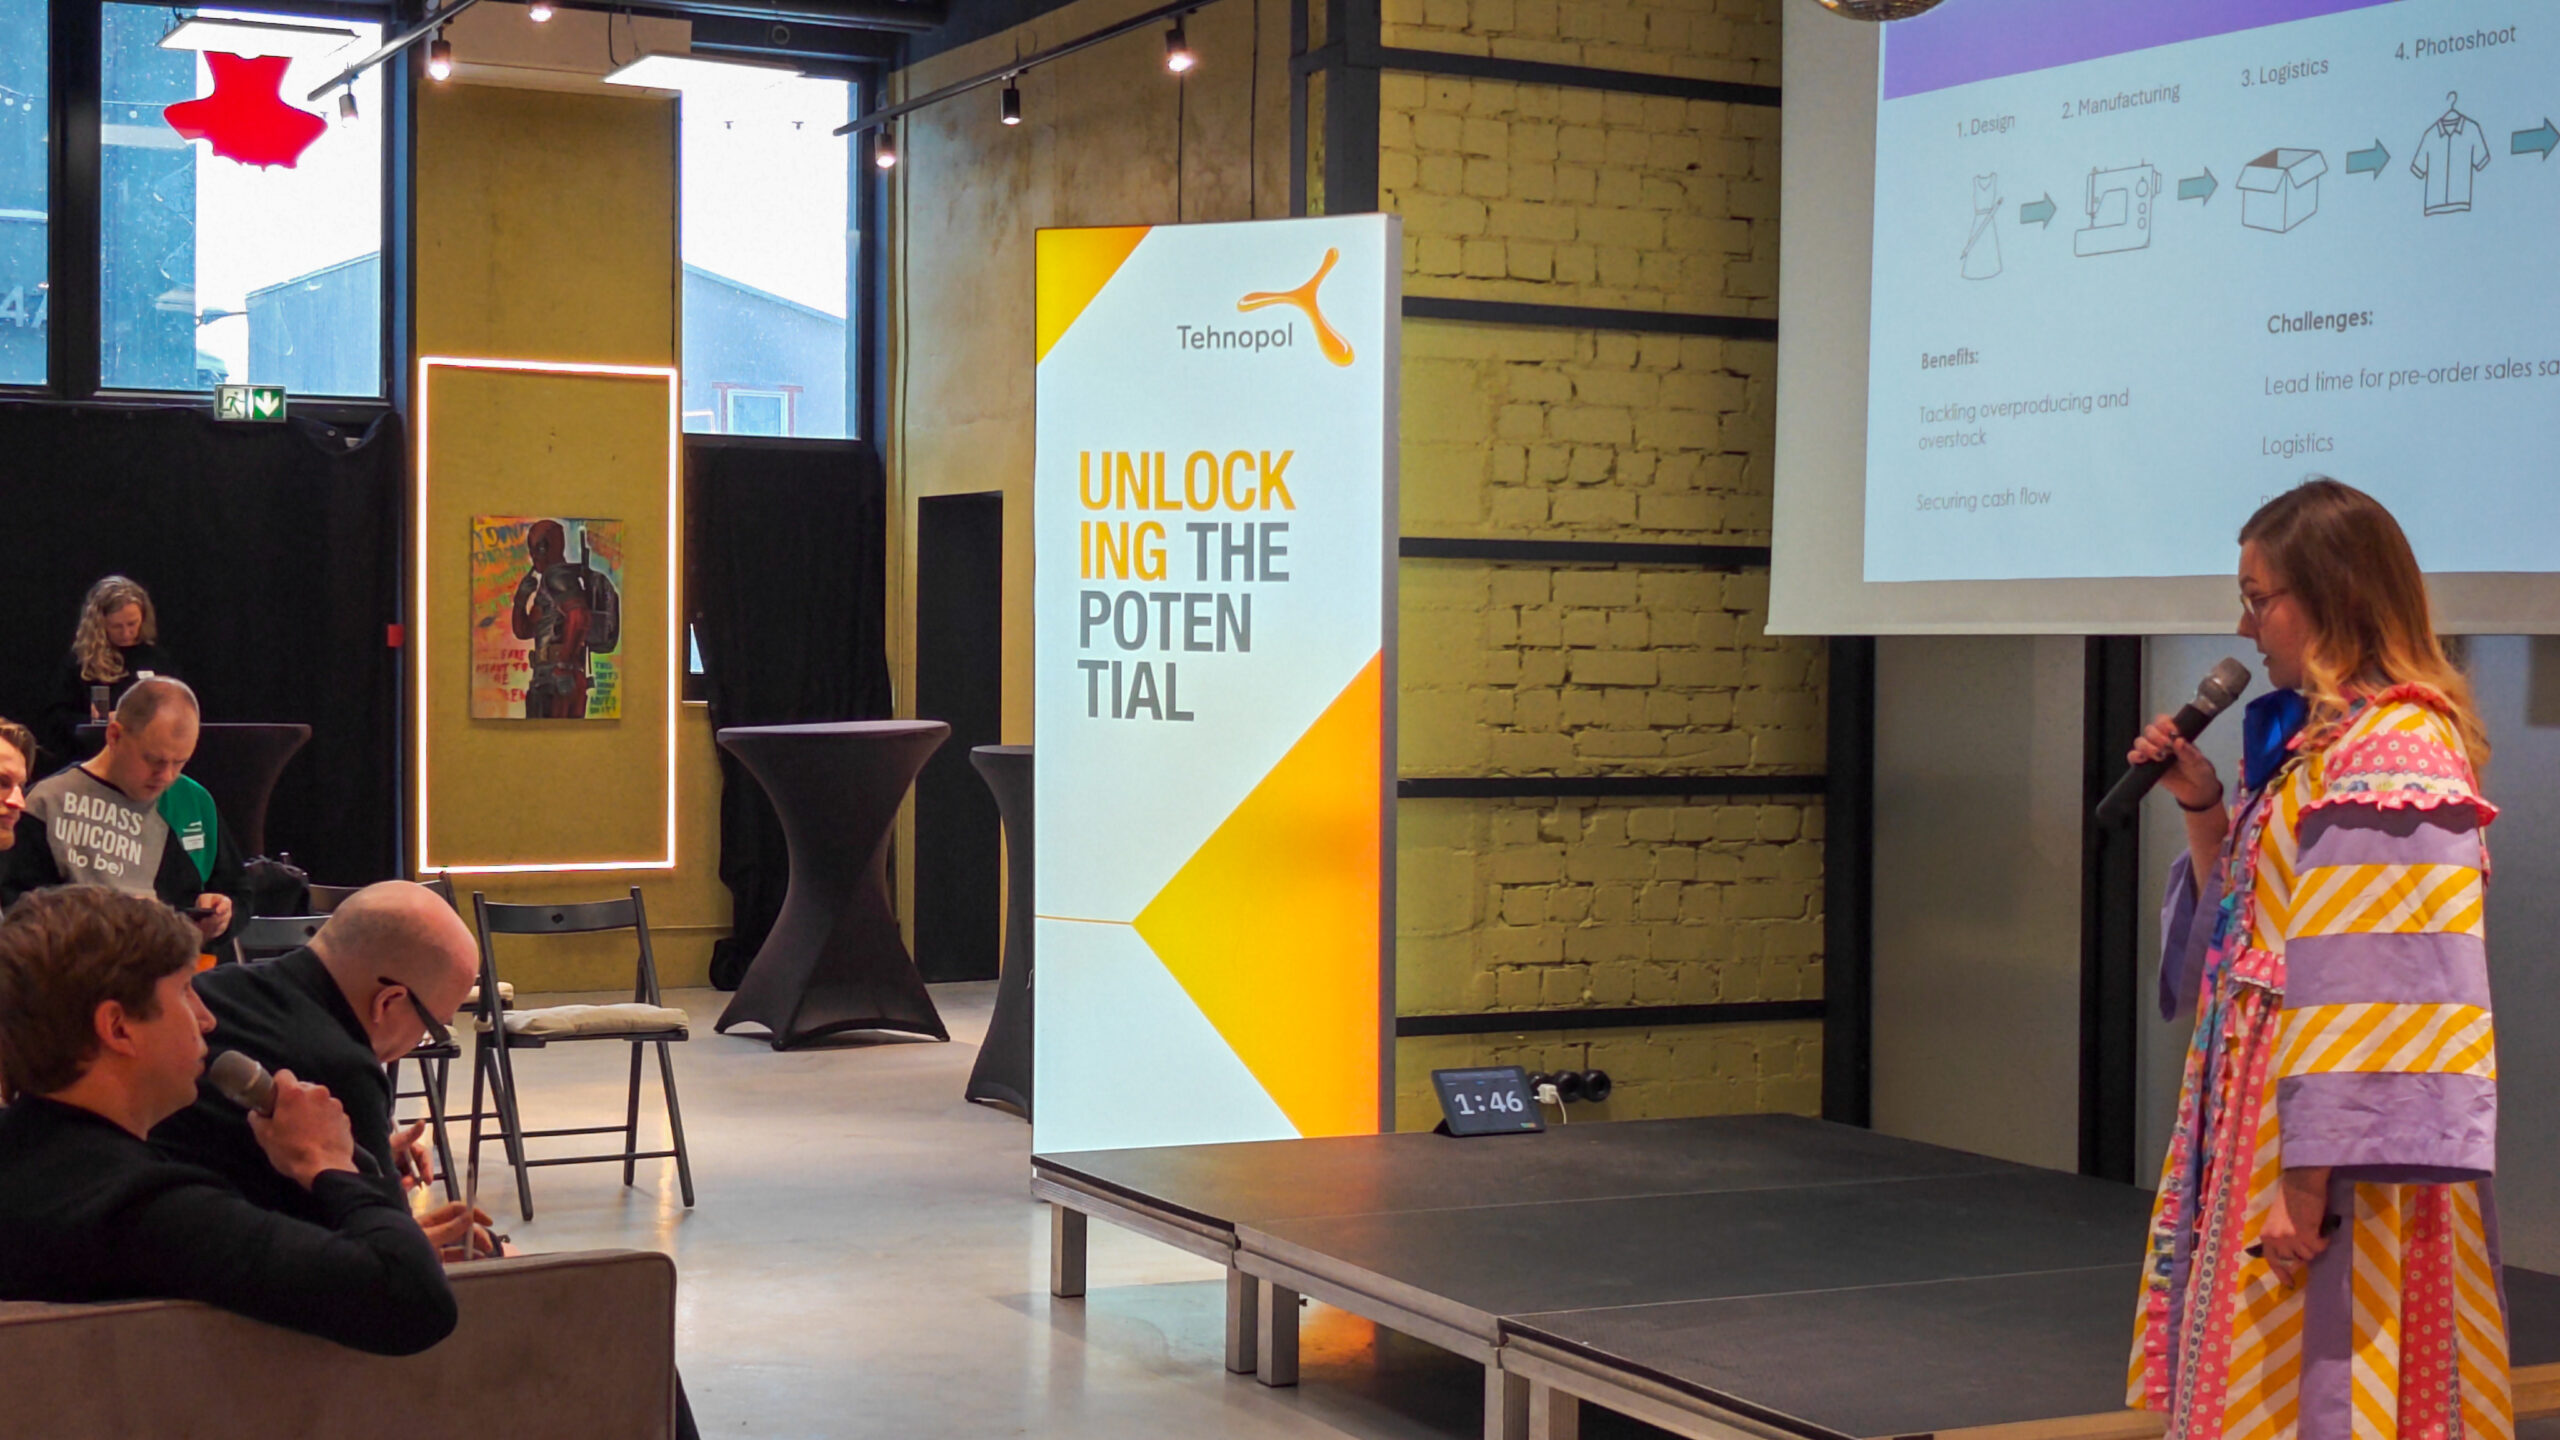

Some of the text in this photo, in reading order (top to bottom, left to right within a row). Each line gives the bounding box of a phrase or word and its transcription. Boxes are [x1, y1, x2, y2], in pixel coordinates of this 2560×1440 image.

[2394, 24, 2517, 60] 4. Photoshoot
[2241, 58, 2329, 87] 3. Logistics
[2061, 83, 2181, 119] 2. Manufacturing
[1957, 114, 2016, 138] 1. Design
[1177, 322, 1293, 354] Tehnopol
[2267, 310, 2374, 334] Challenges:
[1921, 347, 1979, 370] Benefits:
[2264, 373, 2310, 396] Lead
[2316, 370, 2354, 392] time
[2360, 368, 2385, 388] for
[2388, 361, 2480, 391] pre-order
[2484, 357, 2533, 380] sales
[1919, 387, 2130, 424] Tackling overproducing and
[1918, 427, 1987, 450] overstock
[2262, 433, 2335, 459] Logistics
[1079, 450, 1296, 511] UNLOCK
[1916, 487, 2052, 512] Securing cash flow
[1080, 521, 1289, 582] ING THE
[1080, 591, 1251, 653] POTEN
[1077, 660, 1195, 721] TIAL
[63, 792, 144, 836] BADASS
[55, 816, 142, 866] UNICORN
[93, 854, 124, 877] be)
[1454, 1090, 1524, 1115] 1:46
